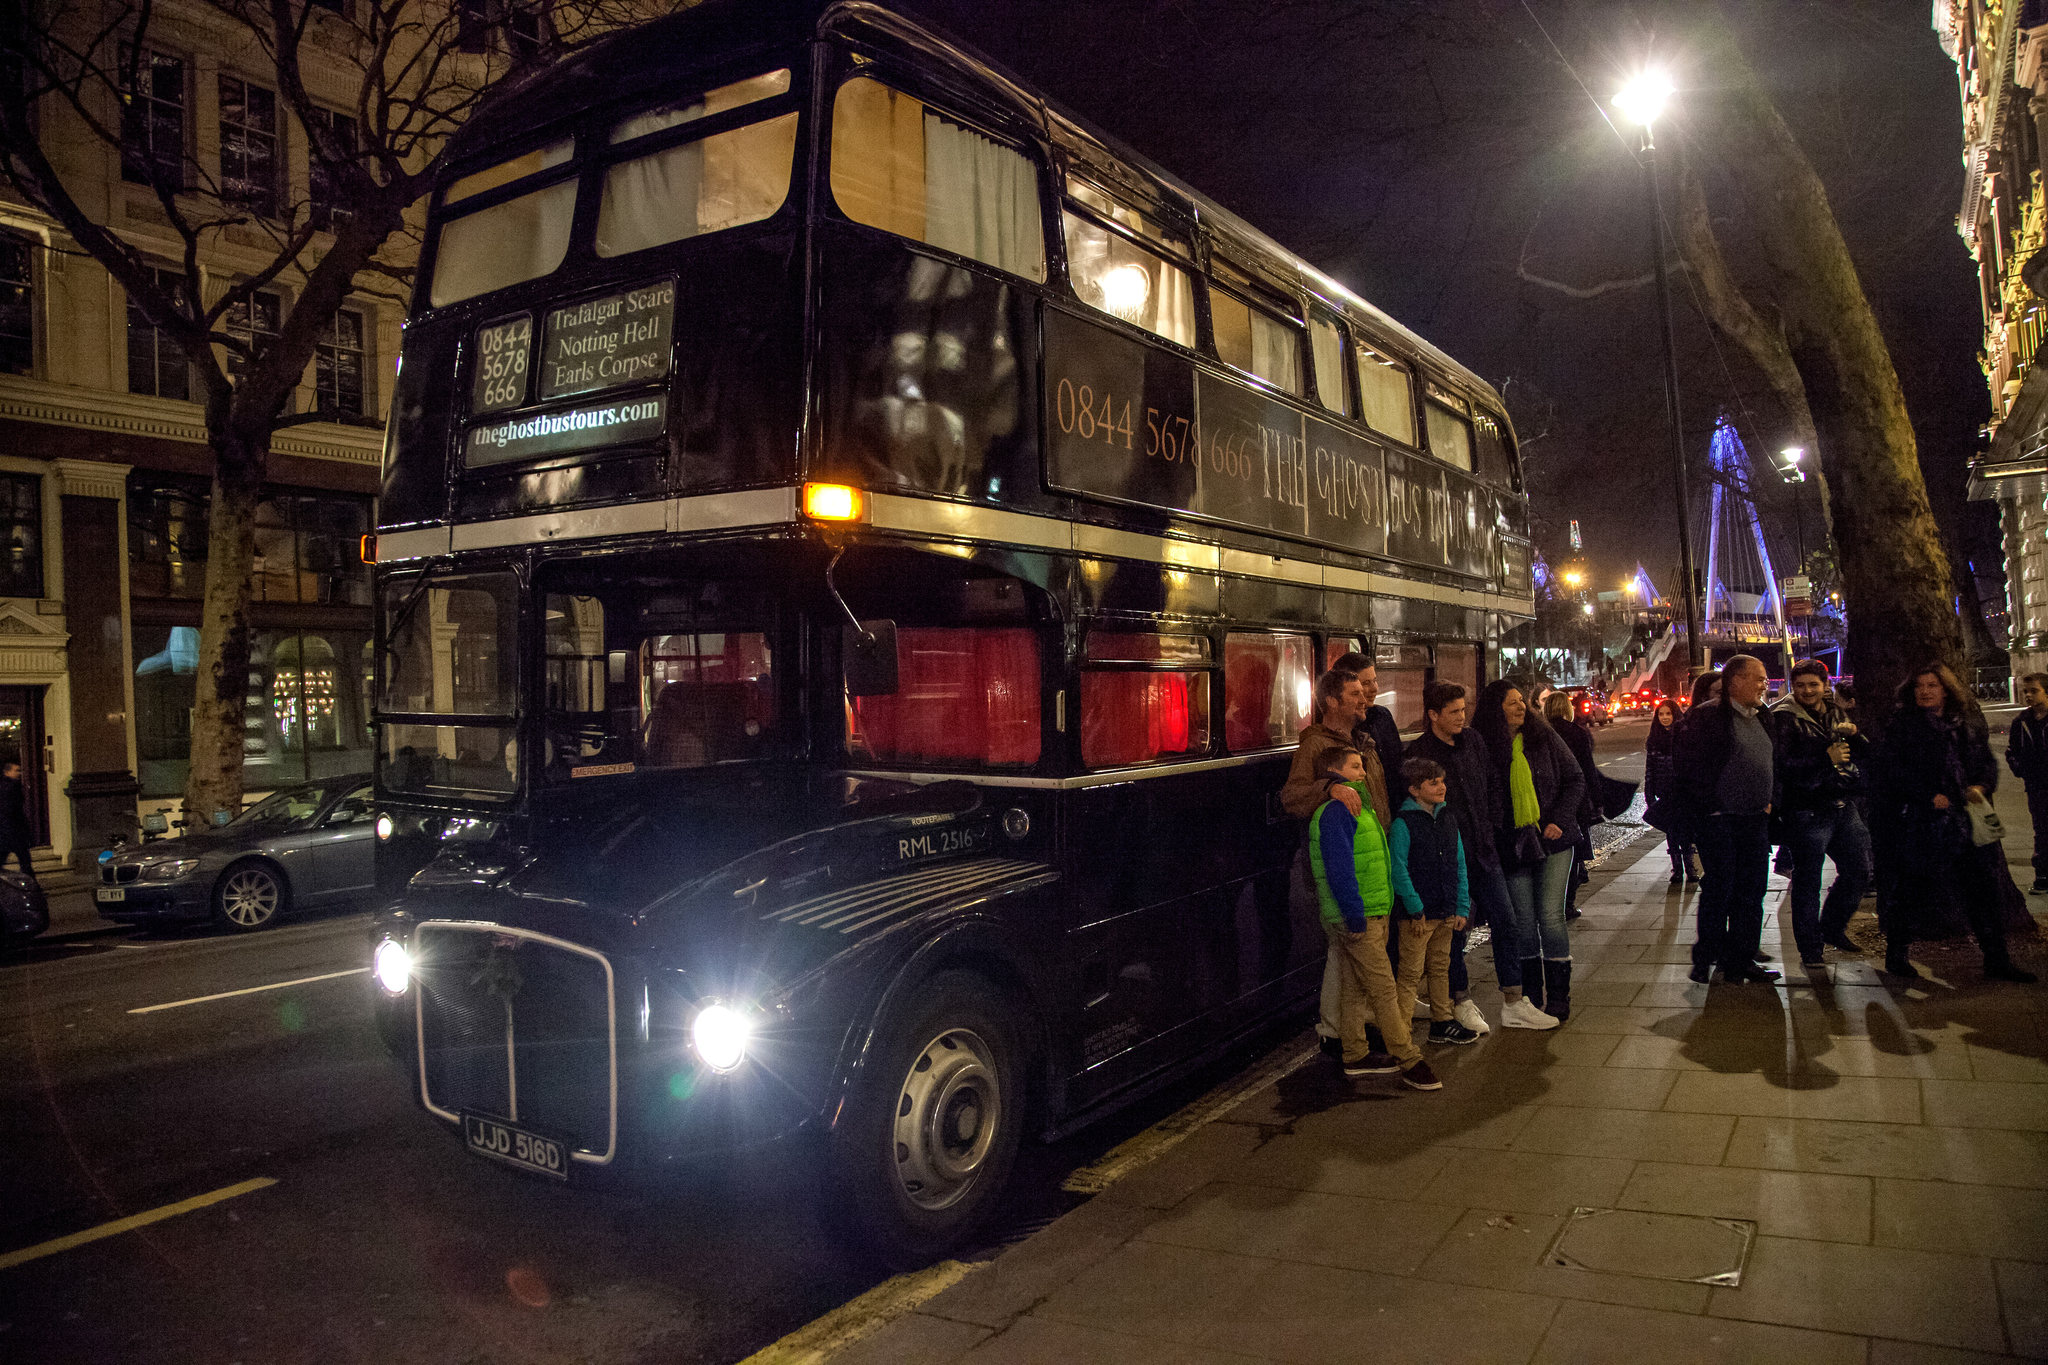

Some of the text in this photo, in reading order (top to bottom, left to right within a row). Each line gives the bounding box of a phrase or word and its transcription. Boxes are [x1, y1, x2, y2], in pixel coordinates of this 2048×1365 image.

[554, 288, 674, 331] Trafalgar Scare
[482, 323, 531, 355] 0844
[559, 316, 659, 359] Notting Hell
[482, 349, 526, 380] 5678
[554, 351, 658, 387] Earls Corpse
[484, 376, 517, 406] 666
[475, 400, 659, 447] theghostbustours.com
[1057, 378, 1252, 481] 0844 5678 666
[1257, 423, 1306, 507] THE
[1315, 445, 1385, 528] GHOST
[1389, 473, 1422, 539] BUS
[571, 763, 633, 777] EMERGENCY EXIT
[899, 828, 973, 860] RML 2516
[473, 1122, 560, 1170] JJD 516D
